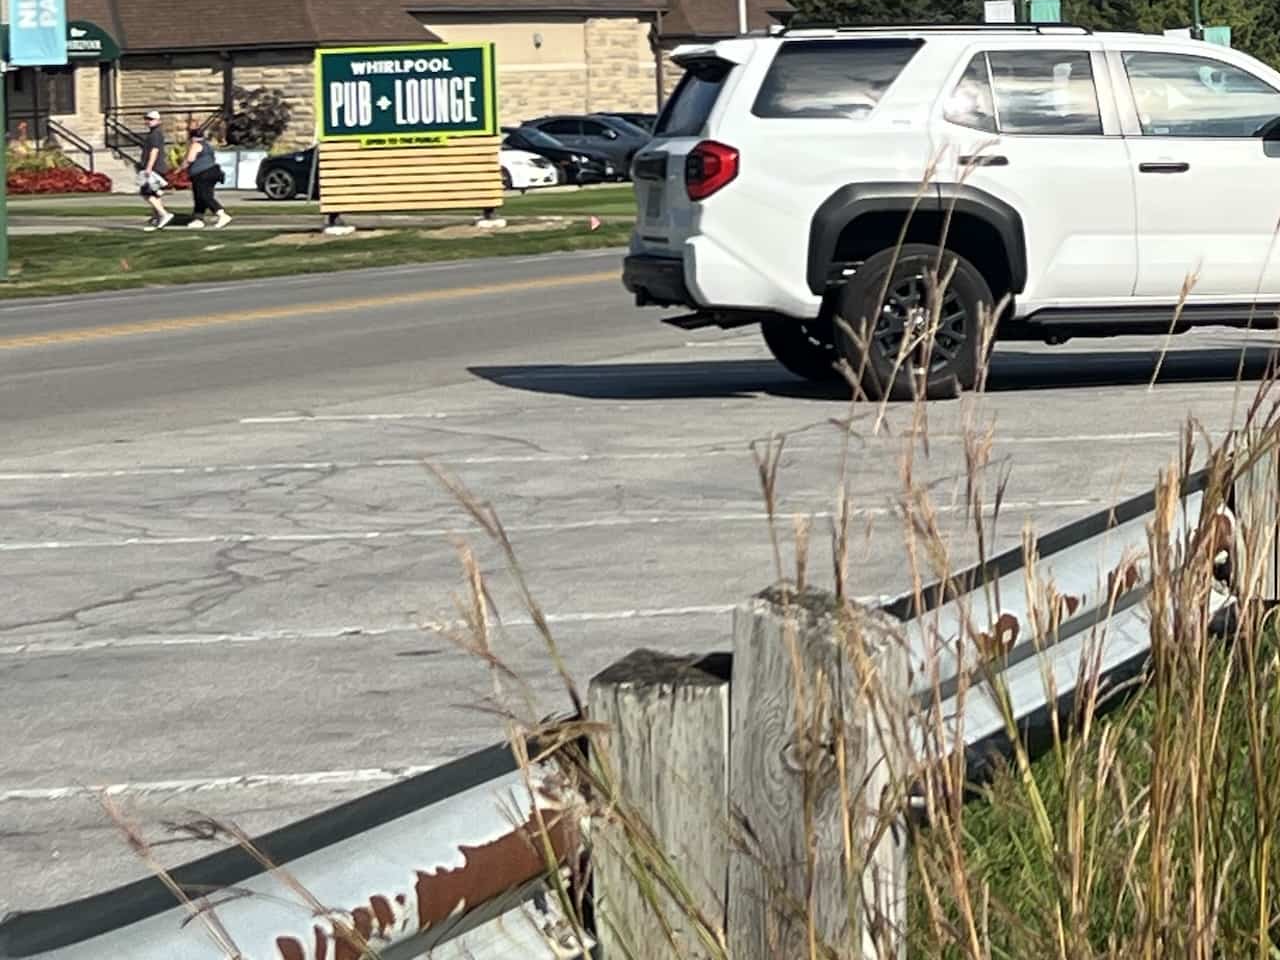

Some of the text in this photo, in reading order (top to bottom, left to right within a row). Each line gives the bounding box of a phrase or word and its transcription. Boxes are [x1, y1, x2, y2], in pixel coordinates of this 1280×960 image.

[351, 58, 453, 75] WHIRLPOOL
[330, 80, 372, 128] PUB
[394, 76, 478, 125] LOUNGE
